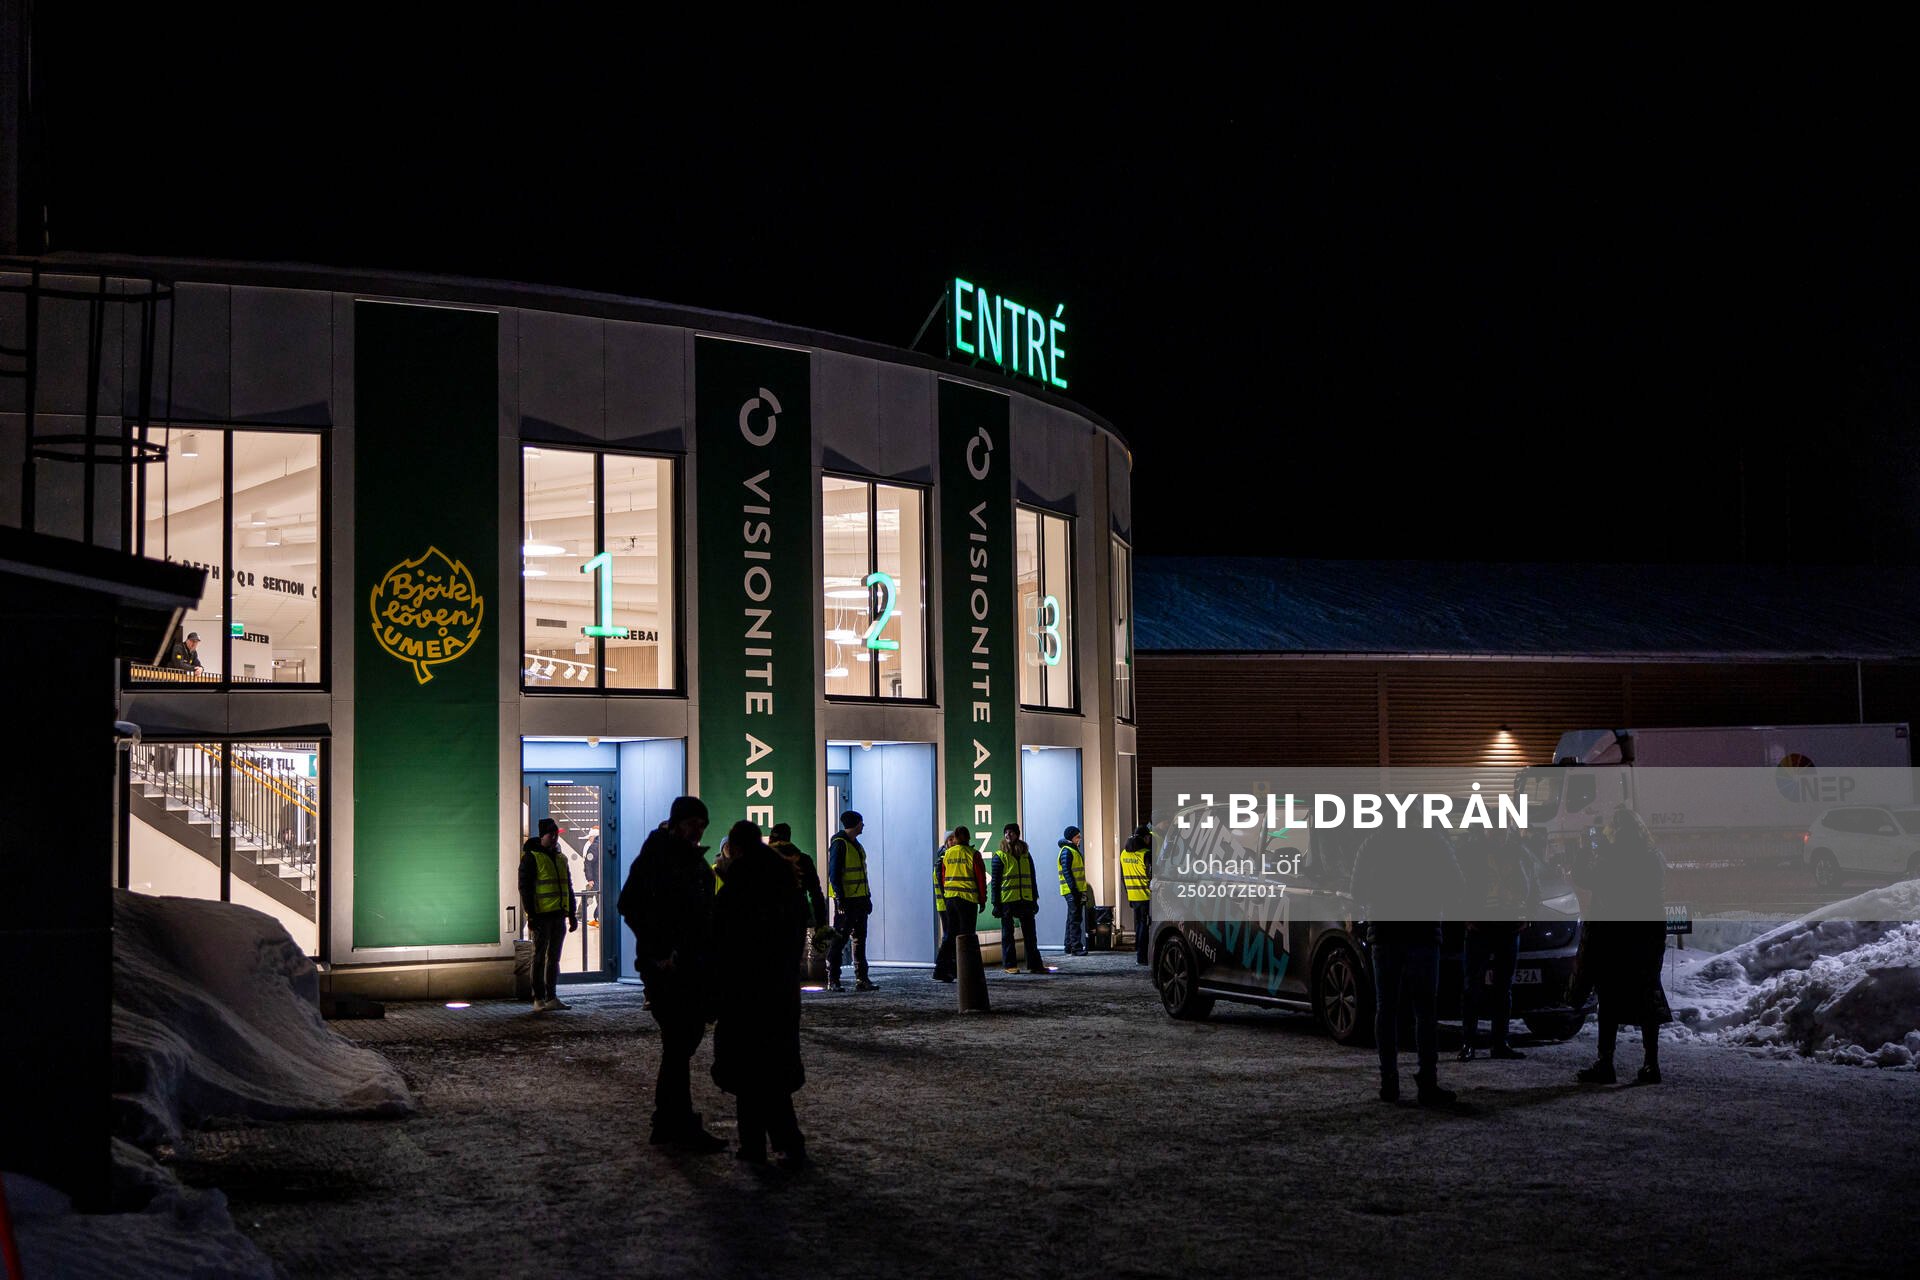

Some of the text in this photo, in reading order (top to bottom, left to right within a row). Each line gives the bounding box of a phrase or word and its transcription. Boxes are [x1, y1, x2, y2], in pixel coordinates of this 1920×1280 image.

[956, 277, 1068, 389] ENTRÉ
[263, 575, 304, 596] SEKTION
[582, 551, 628, 637] 1
[865, 572, 899, 650] 2
[383, 625, 465, 658] UMEÅ
[743, 469, 774, 843] VISIONITE ARE
[1036, 594, 1062, 667] 3
[969, 501, 993, 885] VISIONITE AREN
[276, 758, 295, 770] TILL
[1801, 776, 1855, 802] NEP
[1651, 813, 1685, 824] RV-22
[1188, 929, 1217, 963] måleri
